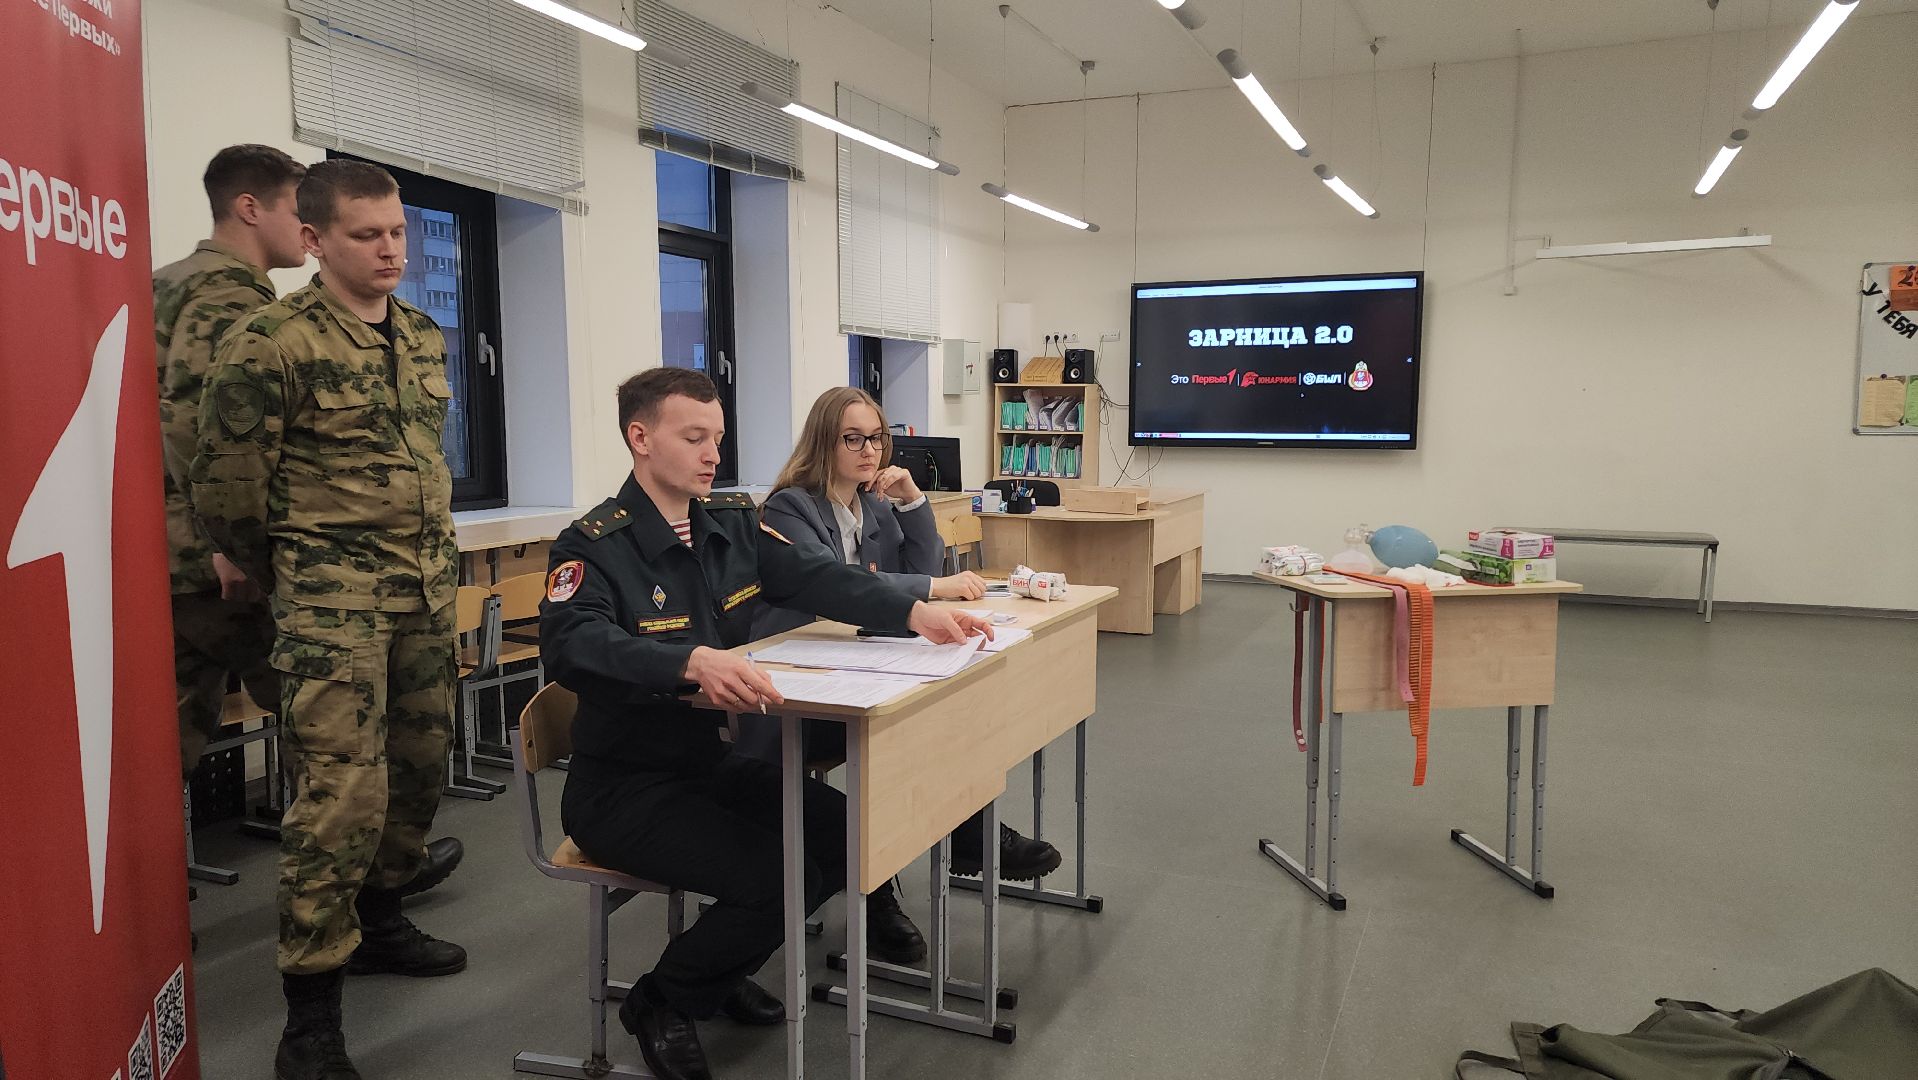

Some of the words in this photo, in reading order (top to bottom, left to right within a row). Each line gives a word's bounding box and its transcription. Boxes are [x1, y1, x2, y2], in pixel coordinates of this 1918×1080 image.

[1188, 326, 1308, 349] ЗАРНИЦА
[1314, 325, 1353, 344] 2.0
[1170, 374, 1189, 384] Это
[1191, 374, 1227, 385] Первые
